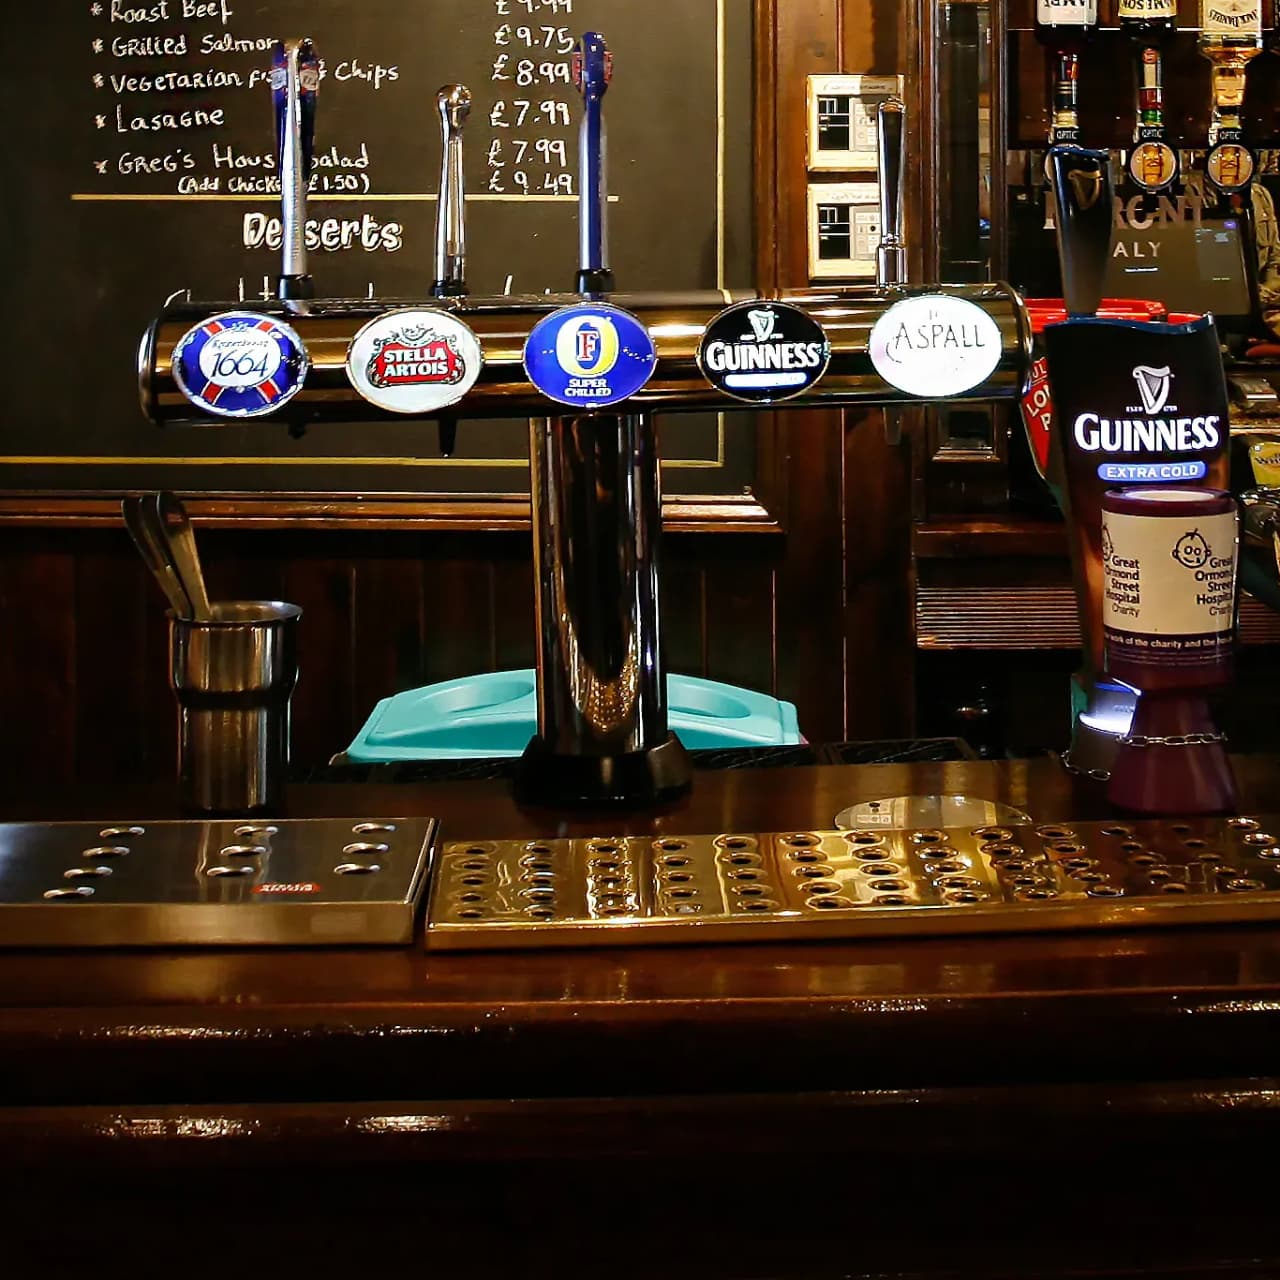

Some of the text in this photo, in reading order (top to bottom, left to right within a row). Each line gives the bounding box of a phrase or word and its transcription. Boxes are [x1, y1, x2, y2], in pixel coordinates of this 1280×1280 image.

[494, 24, 575, 54] £9.75
[334, 58, 400, 90] Chips
[491, 53, 570, 86] £8.99
[489, 100, 570, 127] £7.99
[213, 143, 276, 170] Hous
[487, 138, 568, 168] £7.99
[243, 212, 404, 252] Deserts
[211, 349, 269, 378] 1664
[383, 348, 448, 363] STELLA
[383, 361, 449, 377] ARTOIS
[705, 341, 823, 371] GUINNESS
[564, 387, 612, 398] CHILLED
[568, 377, 607, 388] SUPER
[1074, 413, 1220, 452] GUINNESS
[1106, 465, 1198, 478] EXTRA COLD
[1112, 556, 1140, 570] Great
[1111, 577, 1140, 593] Street
[1150, 638, 1182, 650] charity
[1184, 638, 1201, 648] and
[1202, 637, 1216, 647] the
